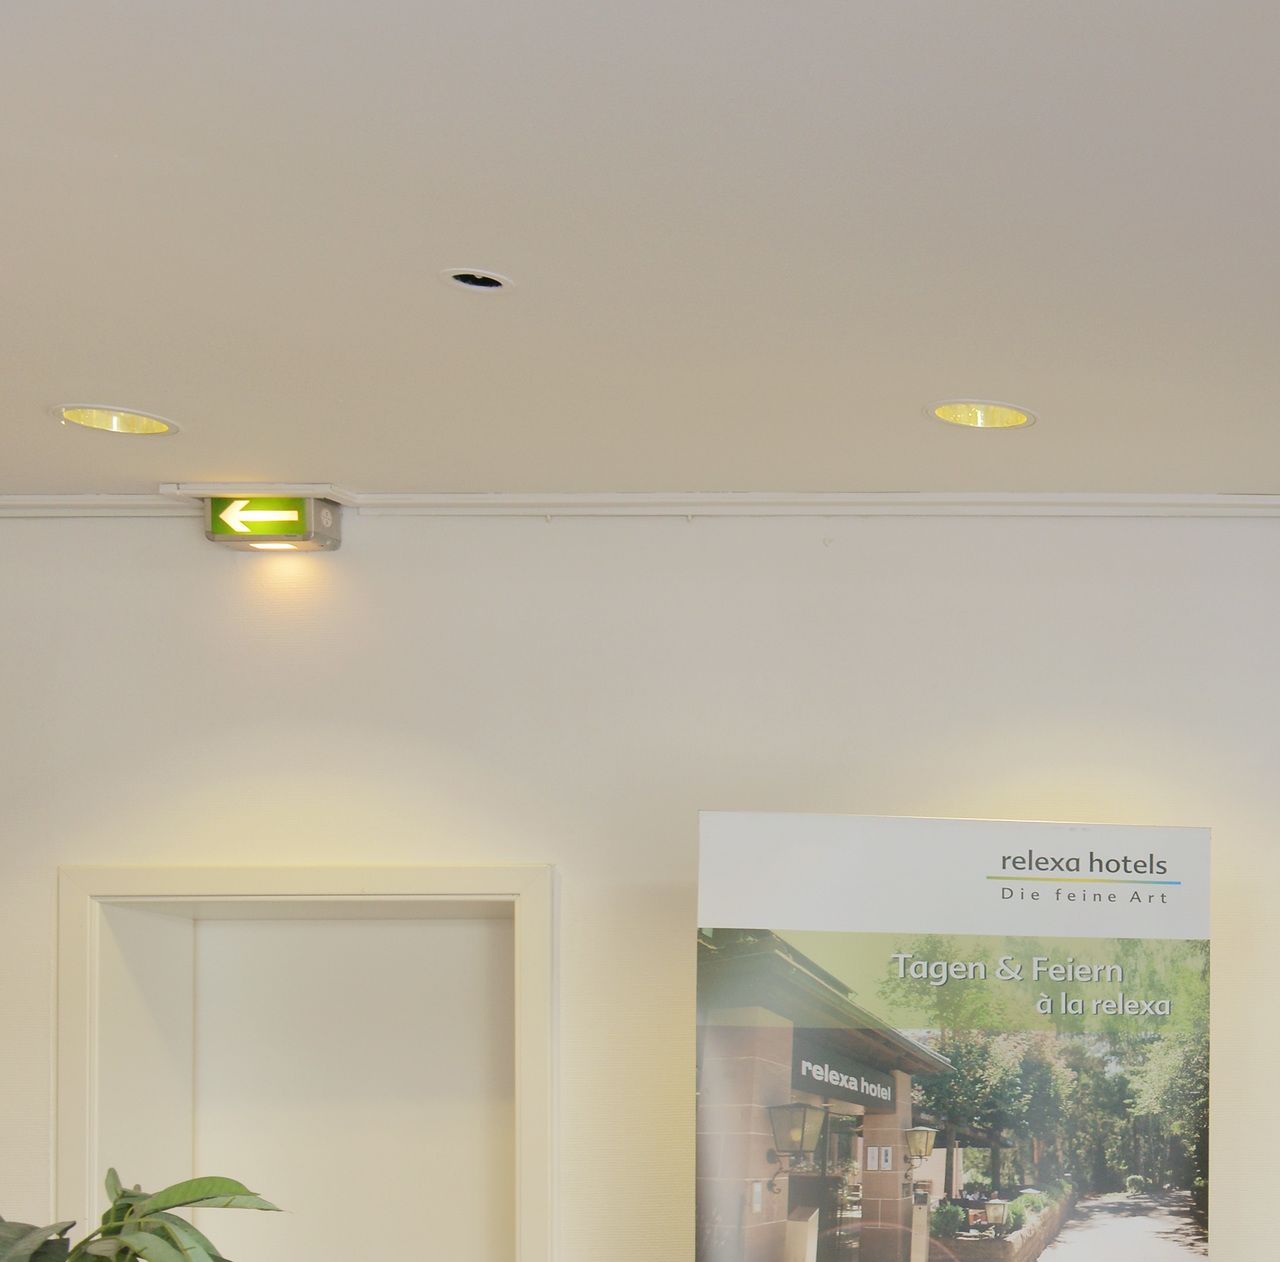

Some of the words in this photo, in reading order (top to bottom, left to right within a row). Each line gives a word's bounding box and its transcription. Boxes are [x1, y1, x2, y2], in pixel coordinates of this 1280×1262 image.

[1002, 849, 1080, 872] relexa
[1089, 851, 1168, 875] hotels
[1001, 887, 1040, 901] Die
[1055, 888, 1117, 903] feine
[1129, 890, 1168, 904] Art
[890, 952, 987, 987] Tagen
[994, 954, 1025, 983] &
[1031, 956, 1125, 984] Feiern
[1036, 992, 1055, 1016] à
[1060, 991, 1085, 1016] la
[1091, 992, 1173, 1017] relexa
[800, 1059, 860, 1092] relexa
[860, 1076, 892, 1102] hotel
